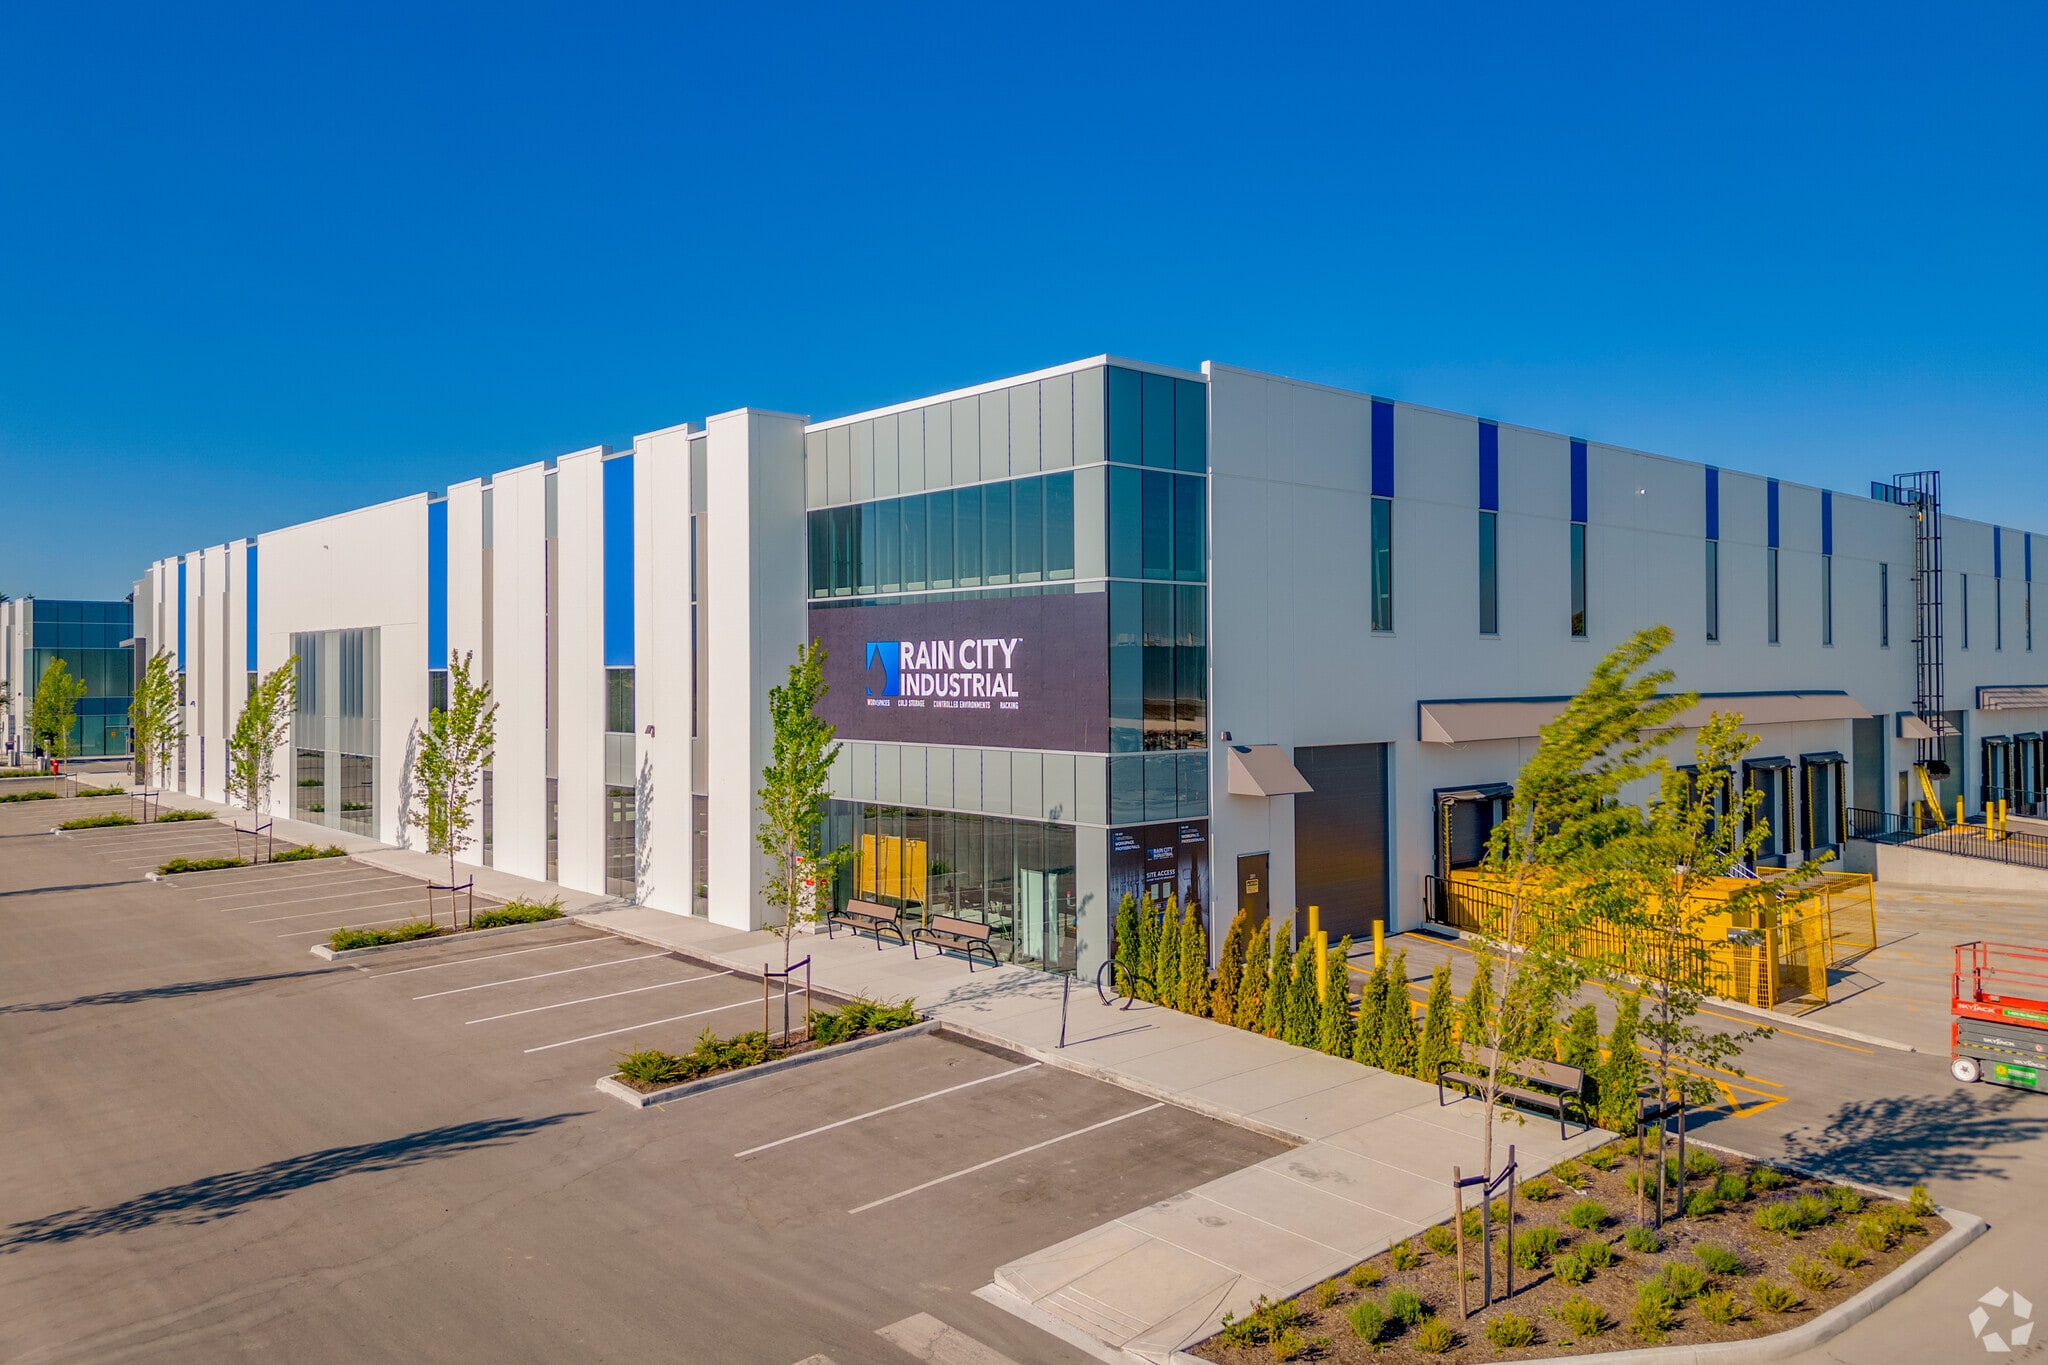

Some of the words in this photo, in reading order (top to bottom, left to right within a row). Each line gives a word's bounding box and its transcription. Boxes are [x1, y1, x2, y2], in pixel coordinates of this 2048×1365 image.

[900, 640, 955, 670] RAIN
[959, 638, 1018, 669] CITY
[900, 673, 1019, 698] INDUSTRIAL
[897, 699, 908, 707] COLD
[908, 699, 926, 708] STORAGE
[933, 700, 959, 709] CONTROLLED
[959, 701, 991, 710] ENVIRONMENTS
[999, 701, 1019, 710] RACKING
[1957, 1003, 1995, 1013] SKYJACK
